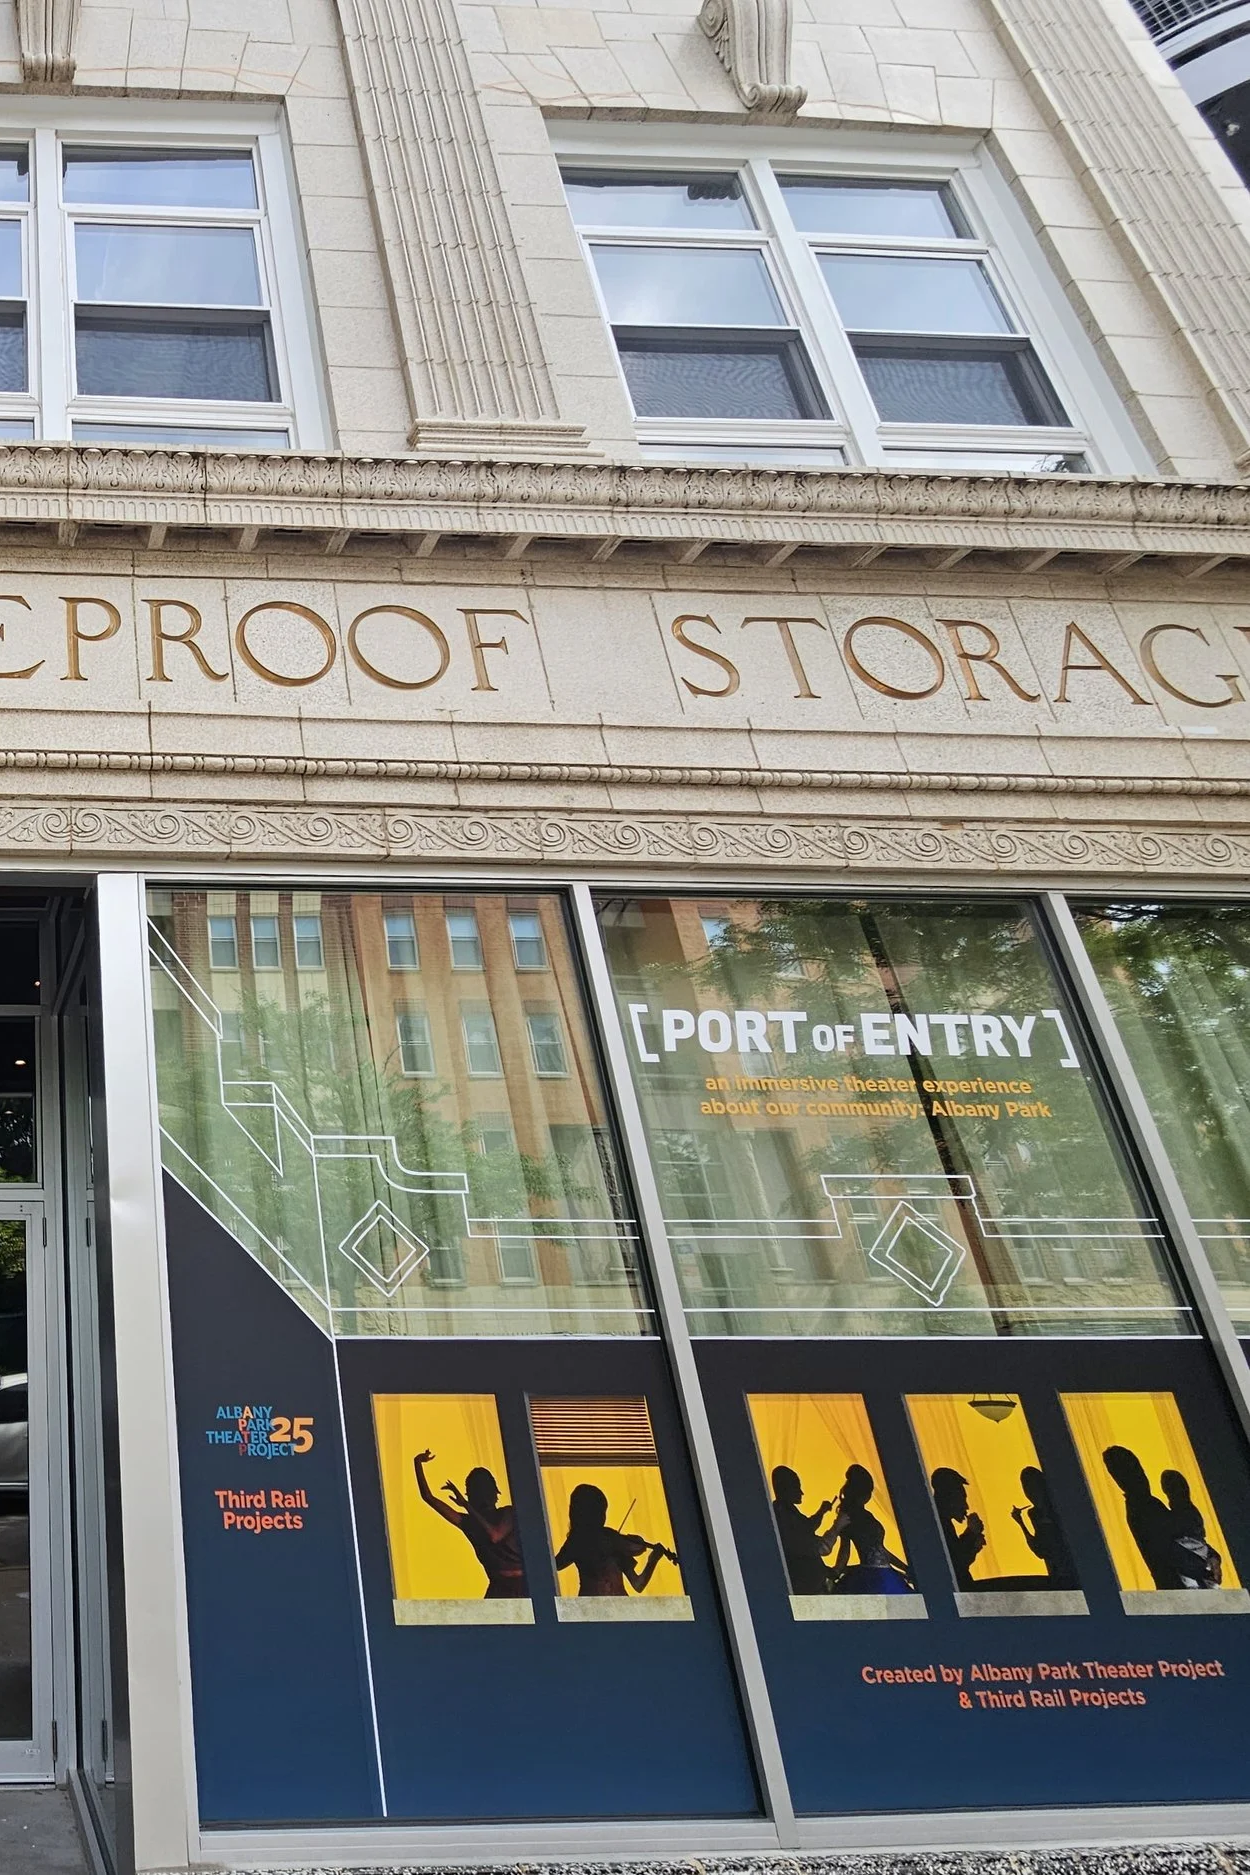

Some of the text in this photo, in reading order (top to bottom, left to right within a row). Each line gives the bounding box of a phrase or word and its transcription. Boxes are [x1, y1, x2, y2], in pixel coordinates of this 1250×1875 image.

[670, 613, 1250, 709] STORAG
[813, 1024, 855, 1053] OF
[705, 1075, 1033, 1096] an immersive theater experience
[700, 1098, 1053, 1121] about our community: Albany Park
[216, 1406, 273, 1419] ALBANY
[206, 1431, 269, 1444] THEATER
[238, 1416, 314, 1454] PARK 25
[239, 1443, 296, 1460] PROJECT
[214, 1490, 309, 1509] Third Rail
[223, 1511, 303, 1534] Projects
[861, 1659, 1225, 1686] Created by Albany Park Theater Project
[958, 1688, 1147, 1710] & Third Rail Projects
